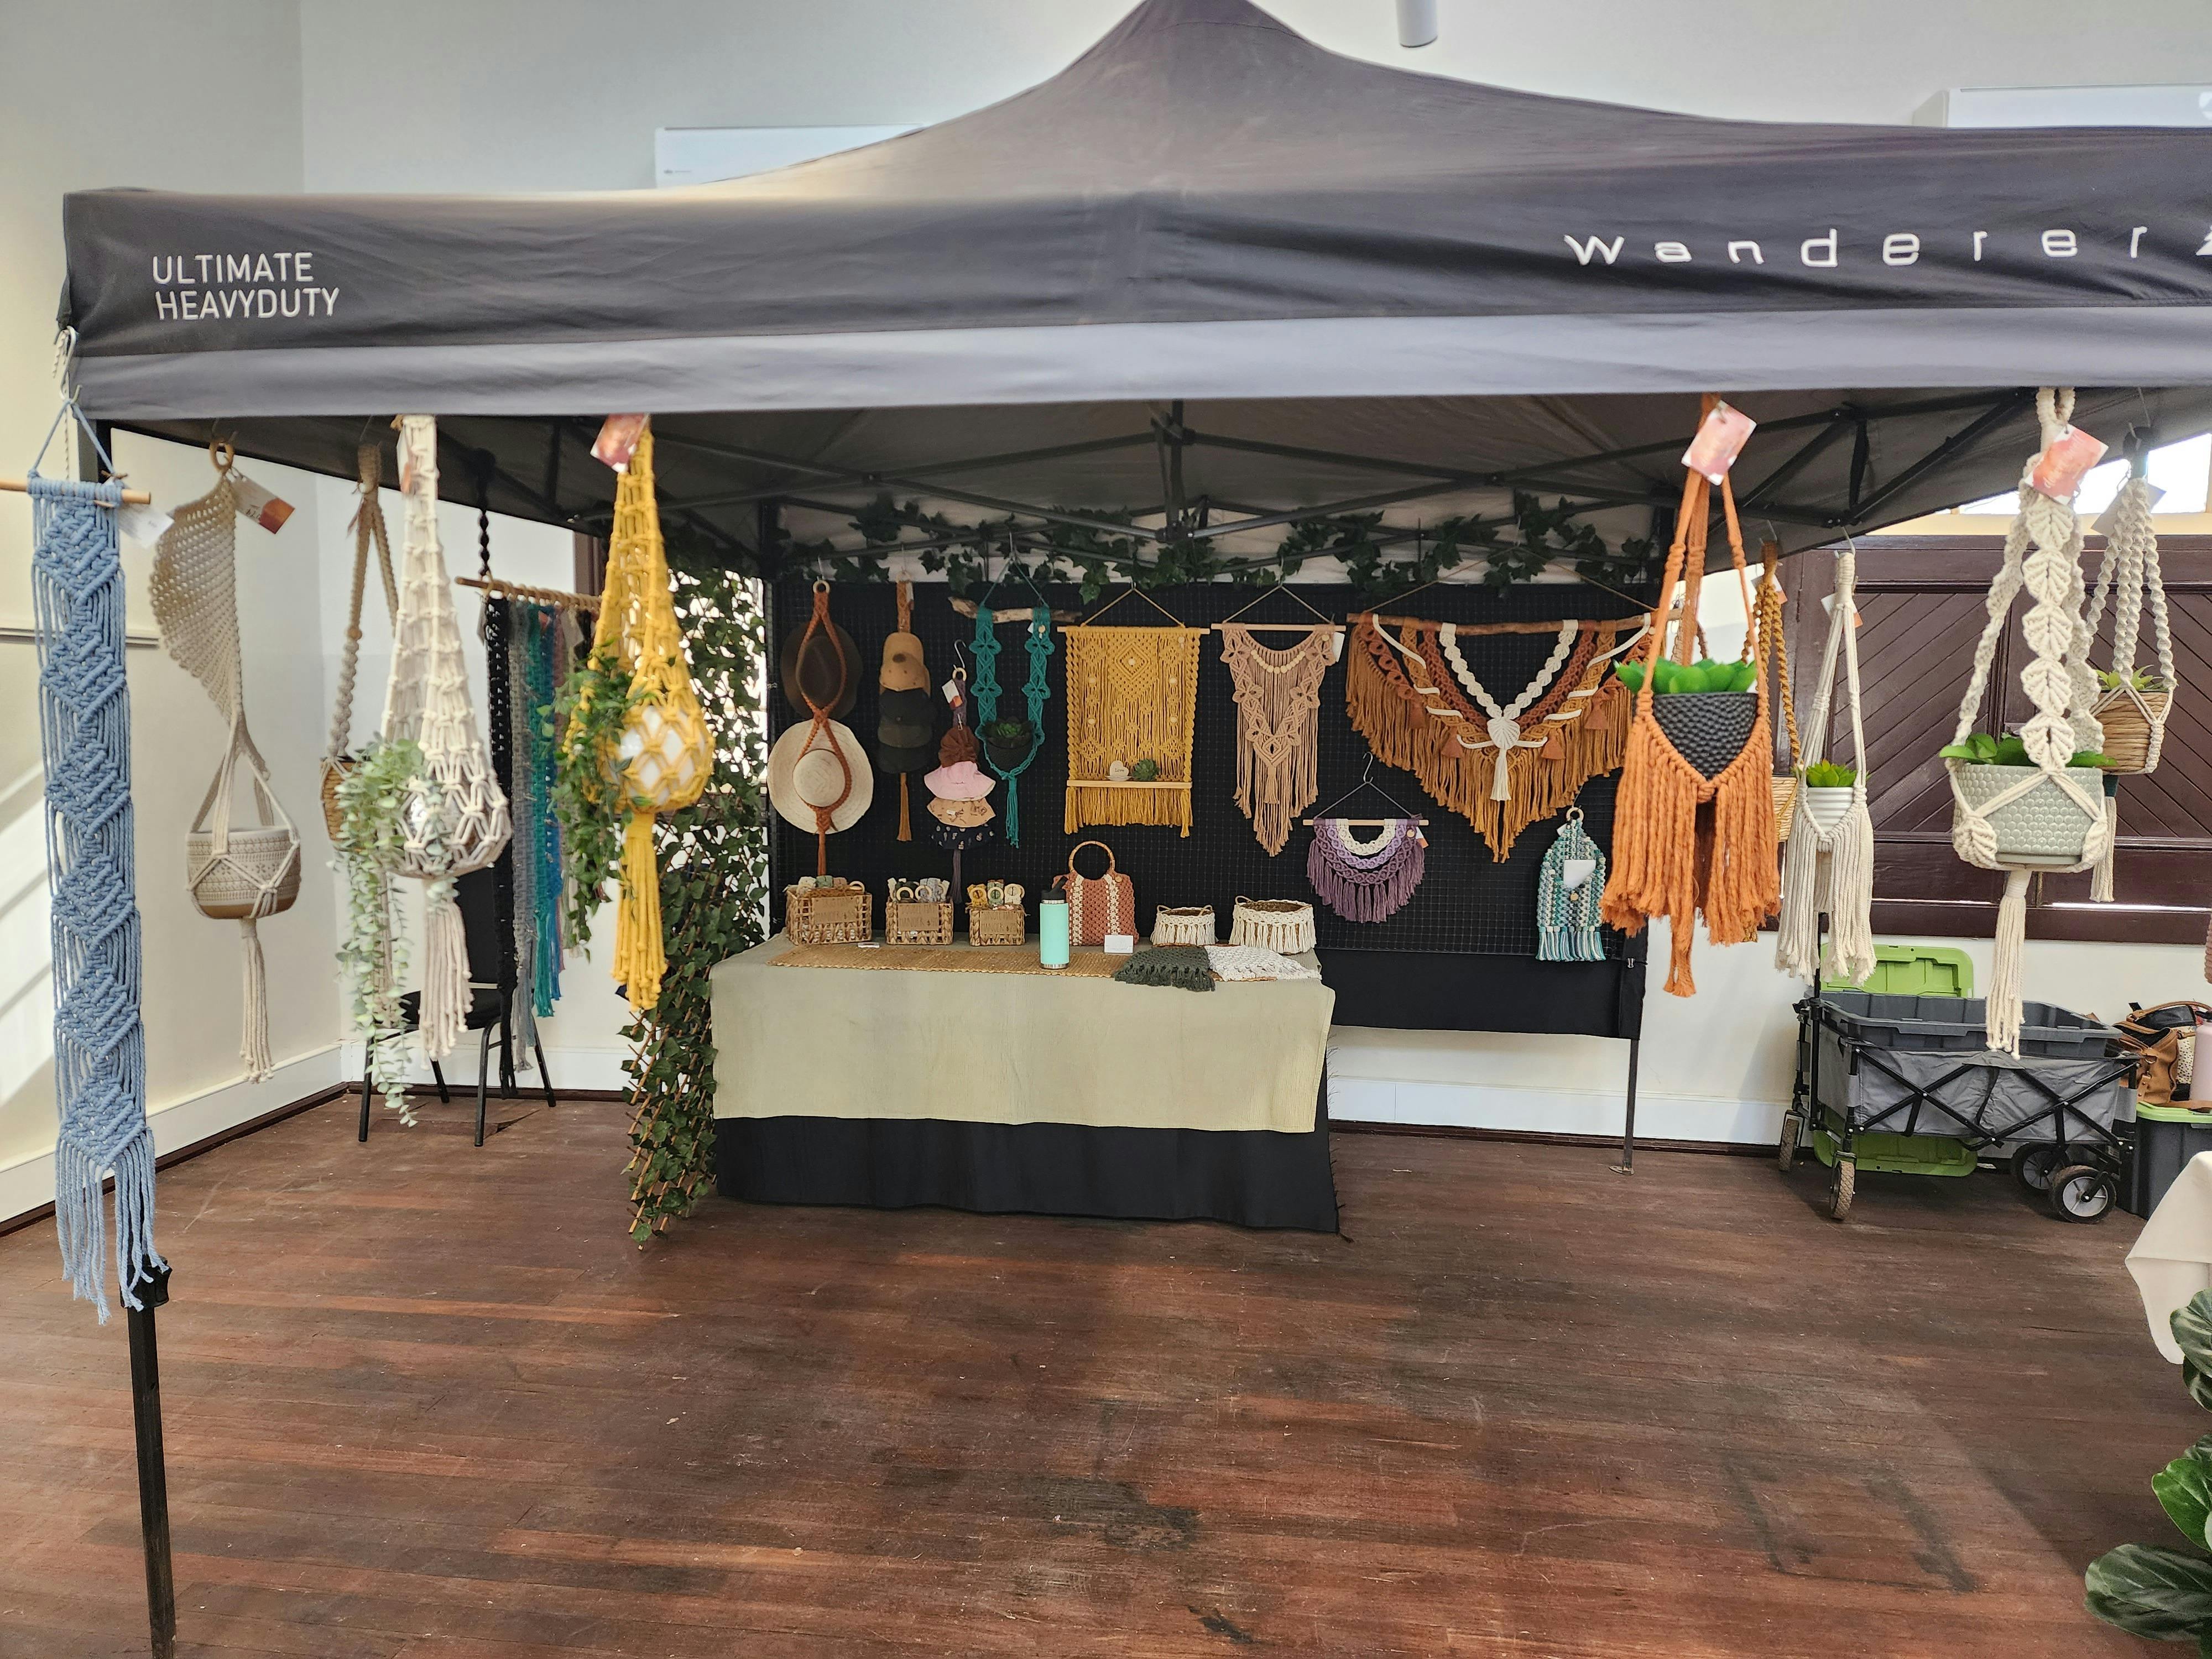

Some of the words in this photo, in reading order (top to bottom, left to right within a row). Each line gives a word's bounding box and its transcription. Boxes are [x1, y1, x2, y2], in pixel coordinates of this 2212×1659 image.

[1564, 226, 2148, 268] wanderer
[152, 252, 314, 284] ULTIMATE
[155, 287, 340, 320] HEAVYDUTY
